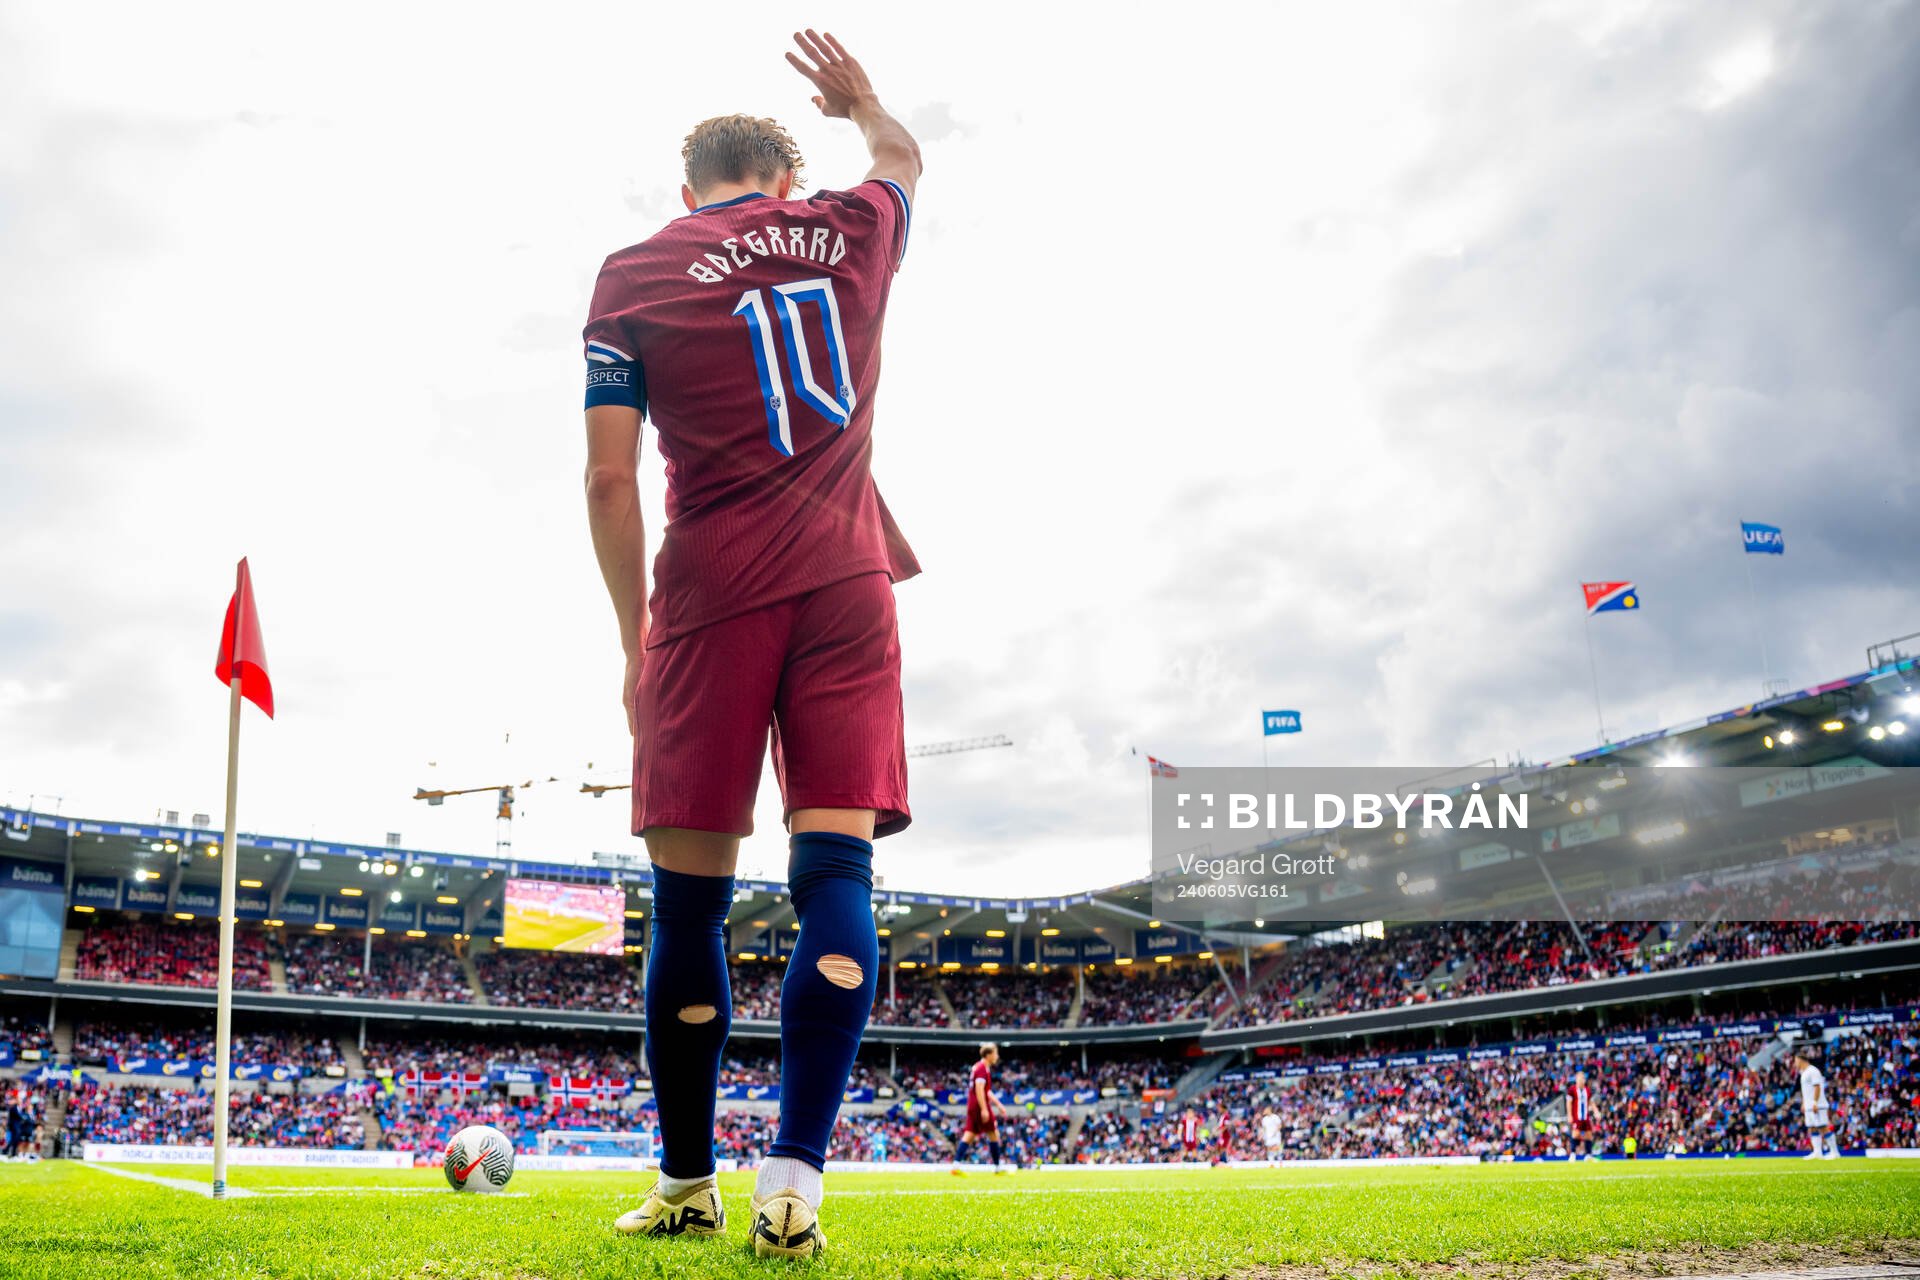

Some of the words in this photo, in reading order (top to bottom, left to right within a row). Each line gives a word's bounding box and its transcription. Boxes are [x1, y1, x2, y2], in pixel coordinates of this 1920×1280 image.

[732, 278, 857, 457] 10
[1744, 530, 1783, 545] UEFA
[1267, 716, 1297, 728] FIFA
[1785, 777, 1818, 791] Nork
[1820, 765, 1866, 783] Tipping
[236, 899, 268, 912] ama
[648, 1206, 716, 1237] AIR
